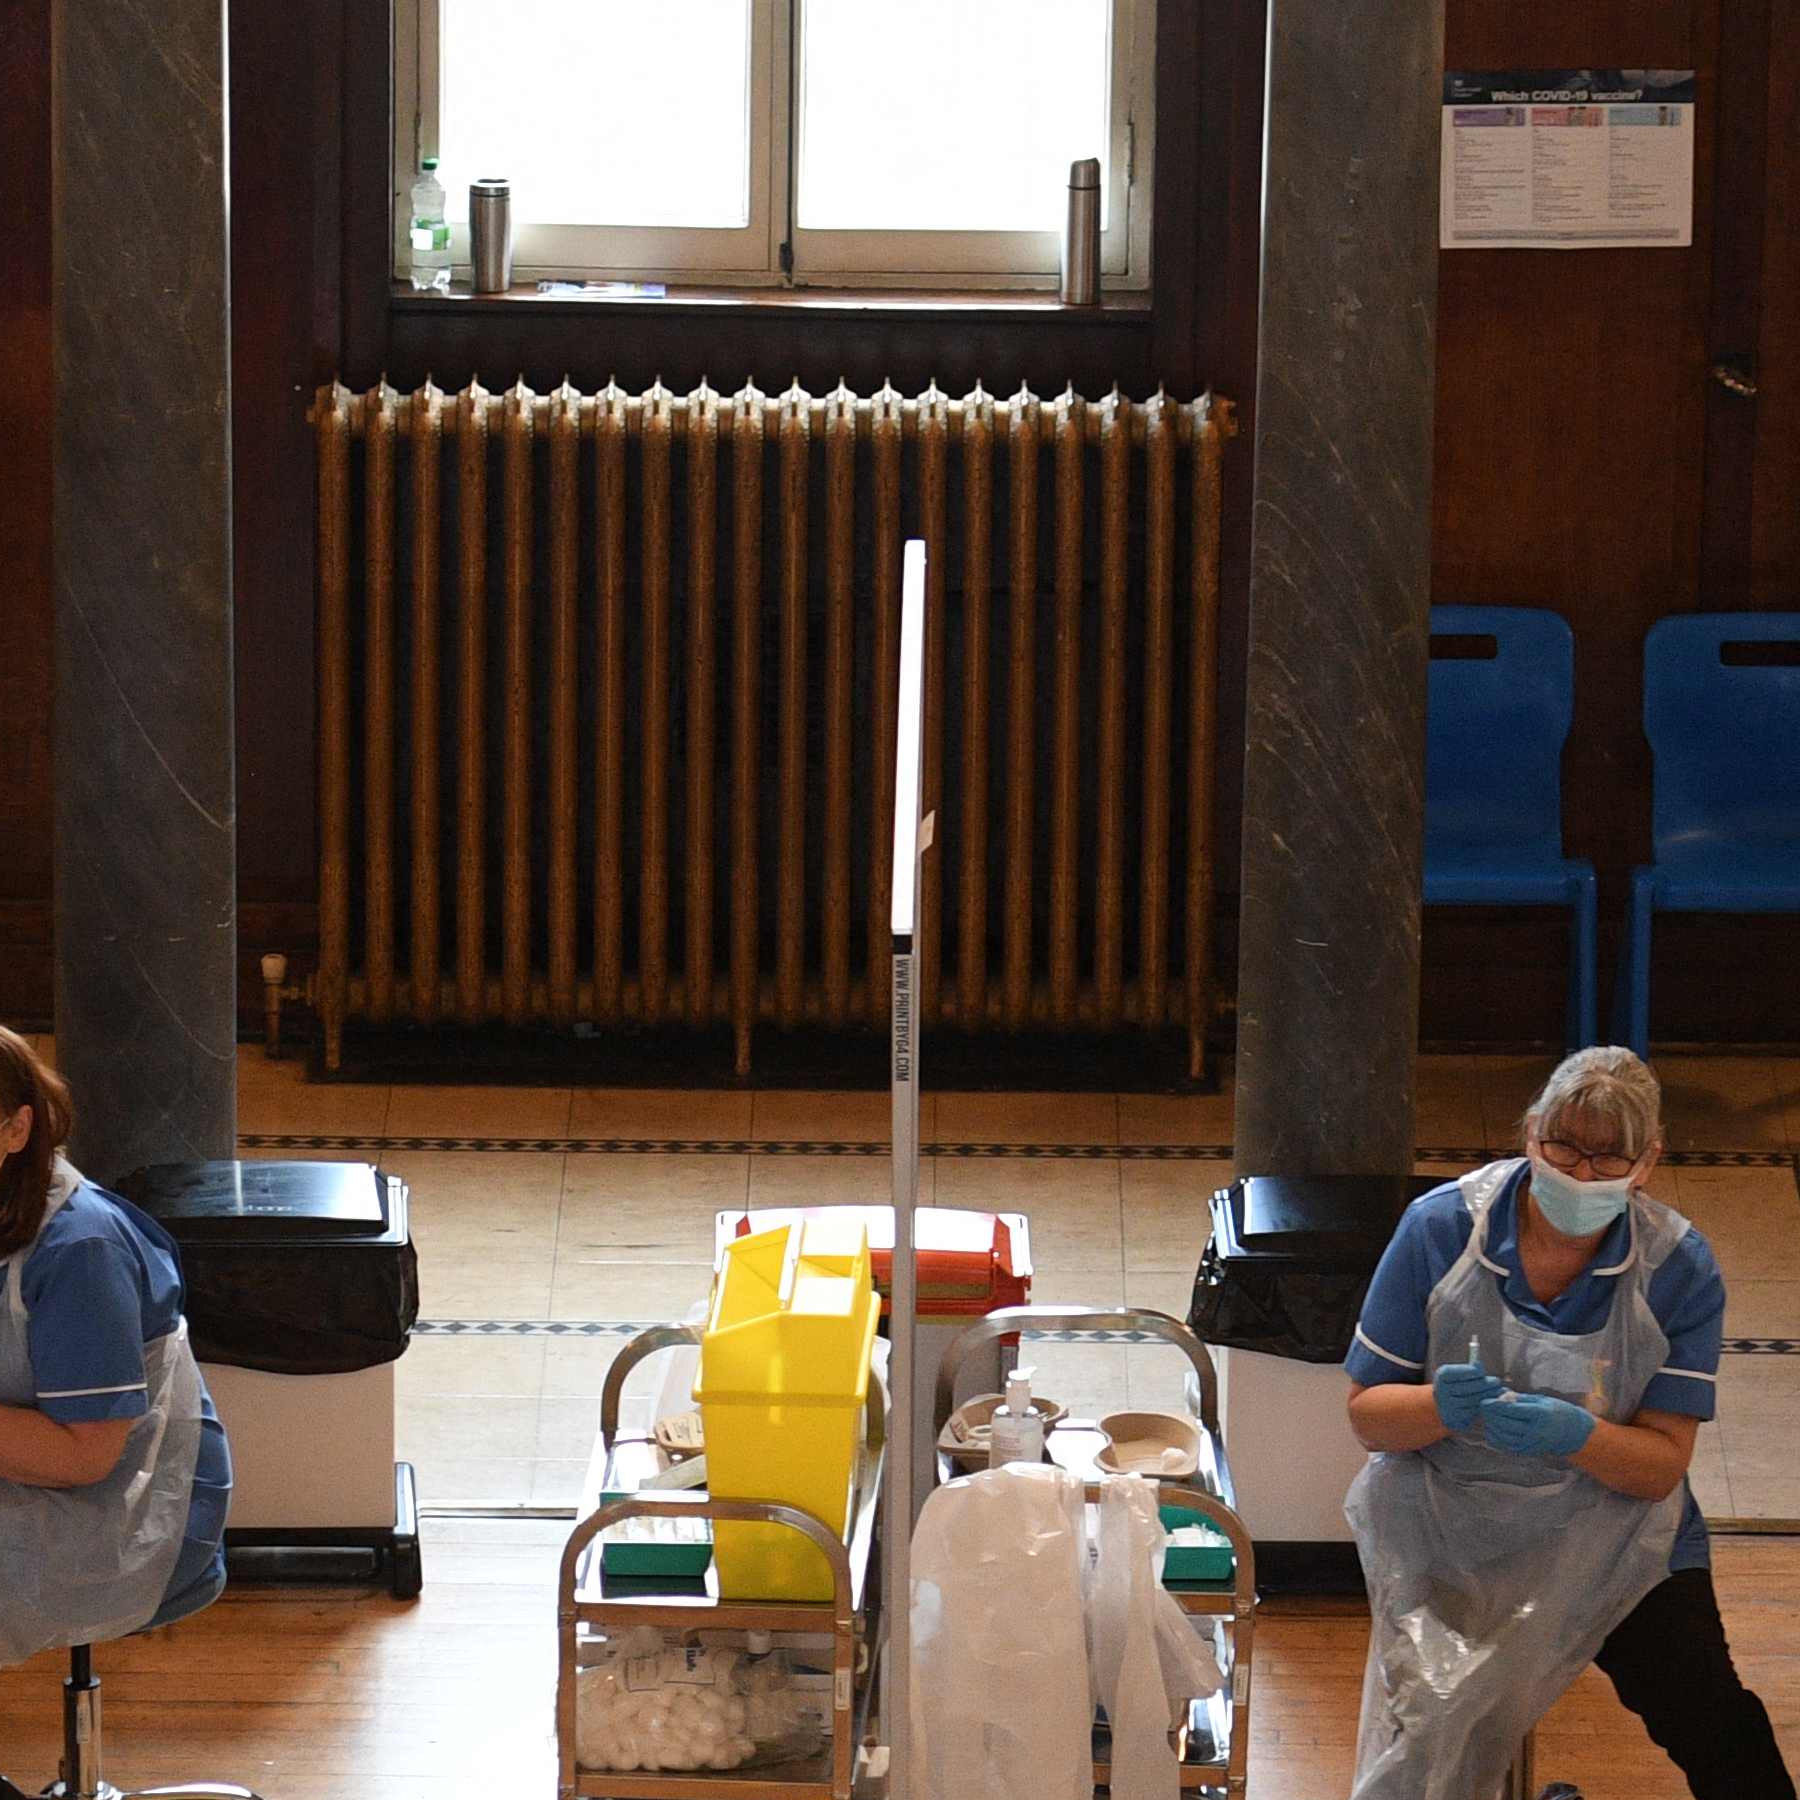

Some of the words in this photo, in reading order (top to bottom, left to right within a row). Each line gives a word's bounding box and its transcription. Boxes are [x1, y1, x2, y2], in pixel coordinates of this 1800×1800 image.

[1492, 92, 1528, 102] Which
[1531, 91, 1588, 101] COVID-19
[1591, 90, 1643, 100] vaccine?
[895, 959, 910, 1082] WWW.PRINTBYG4.COM
